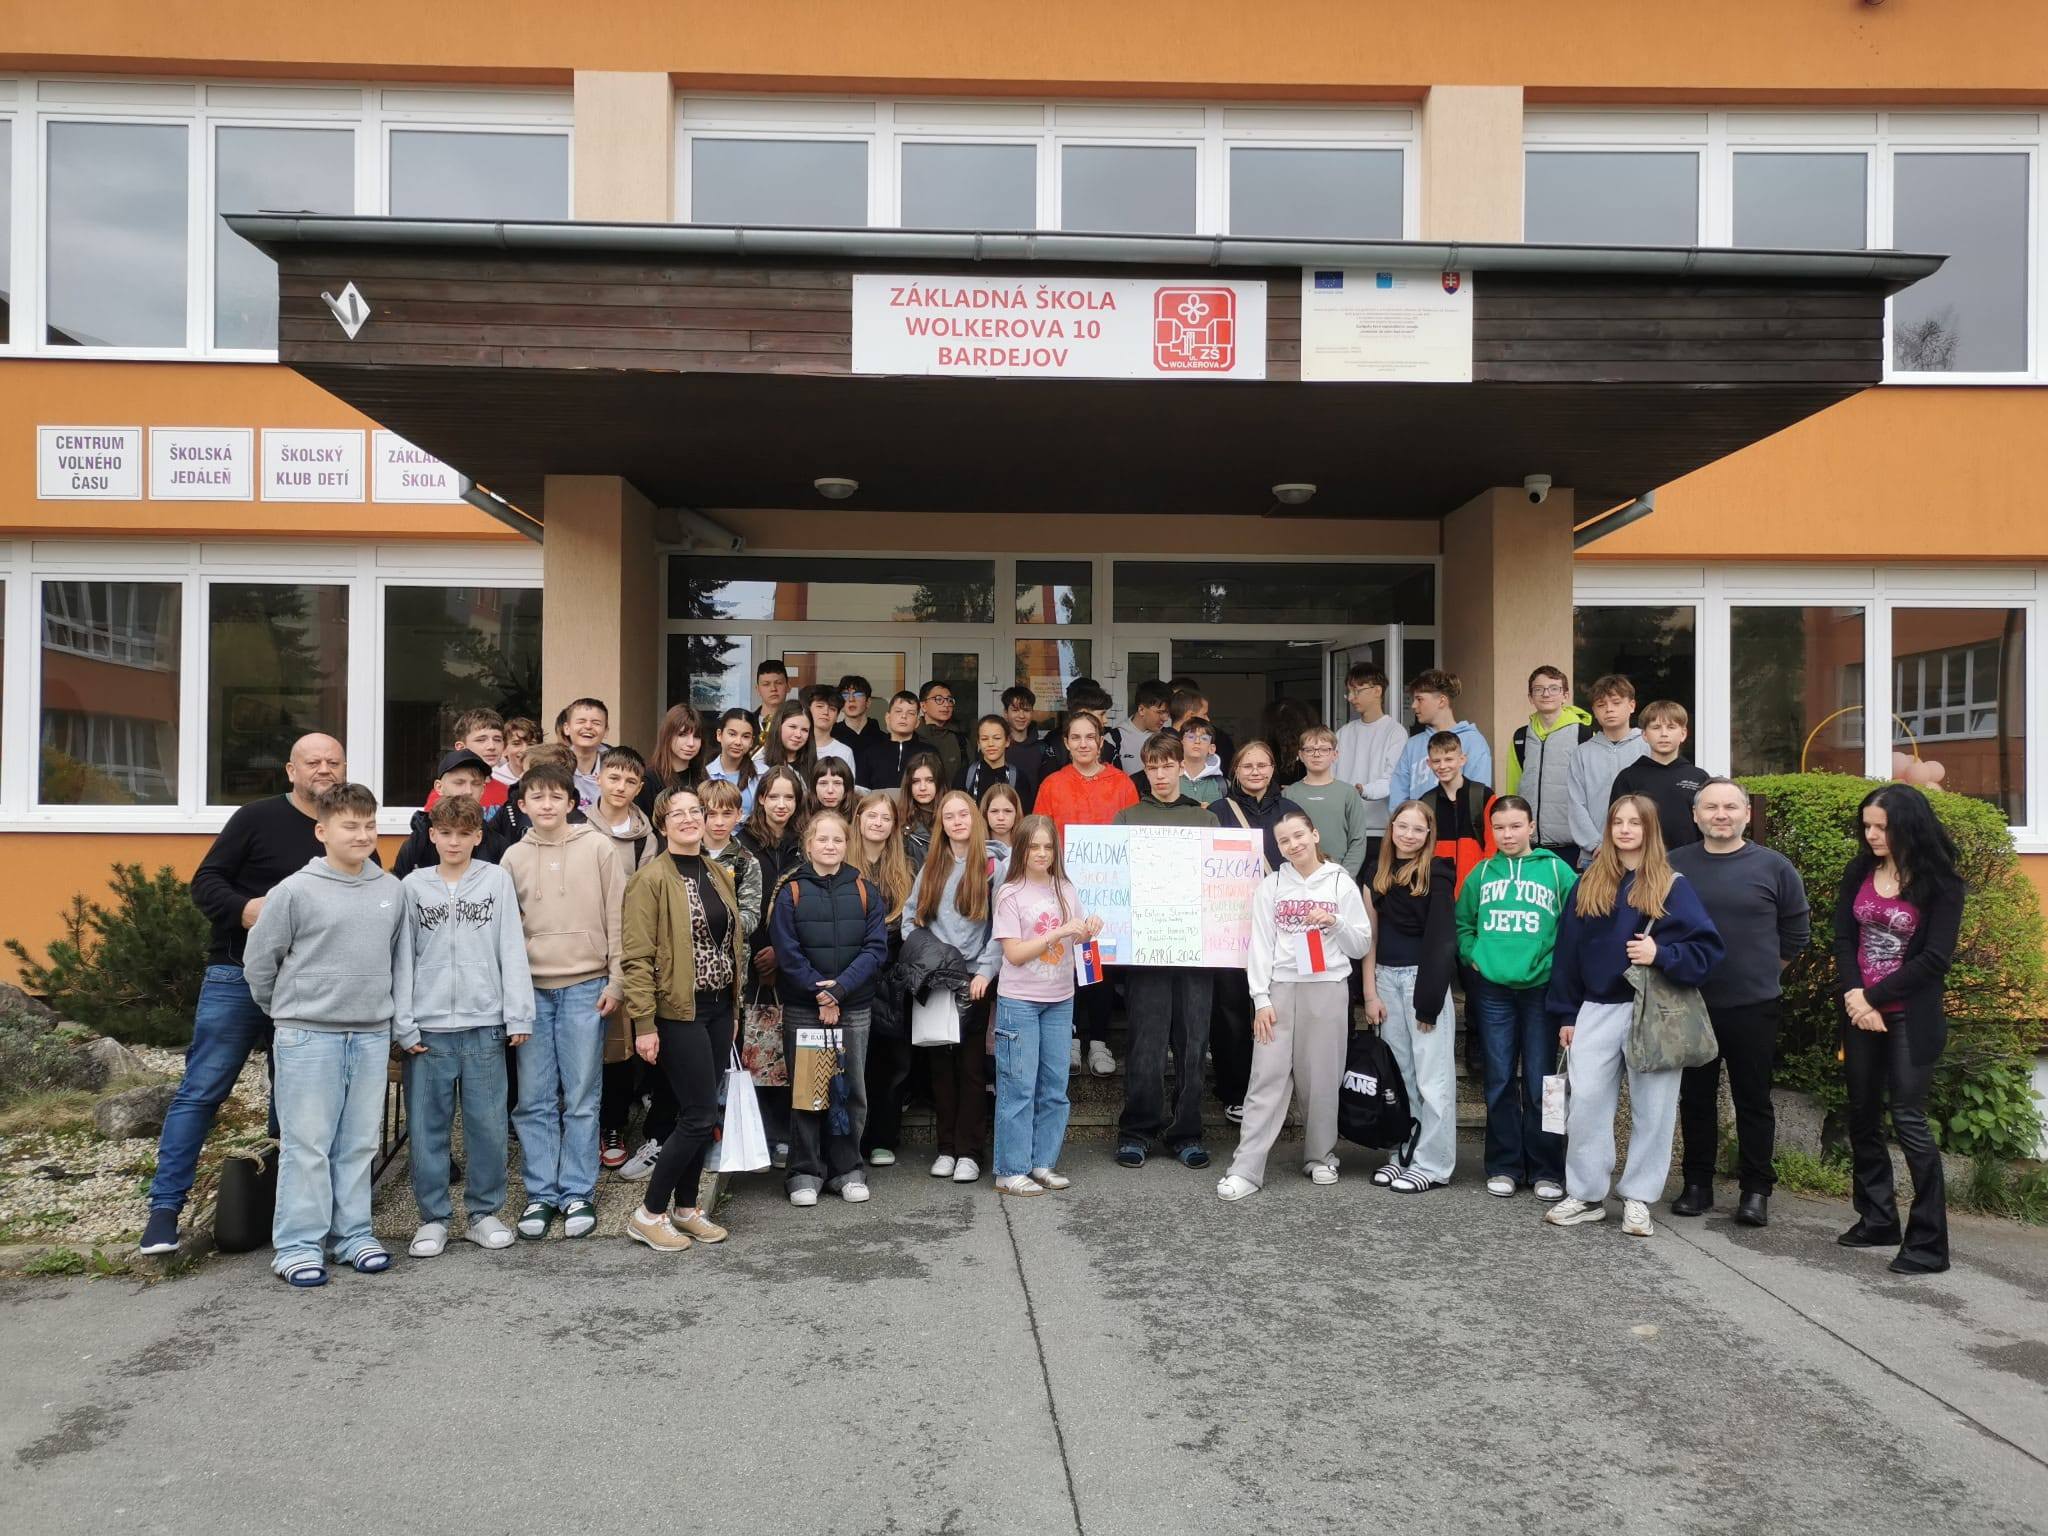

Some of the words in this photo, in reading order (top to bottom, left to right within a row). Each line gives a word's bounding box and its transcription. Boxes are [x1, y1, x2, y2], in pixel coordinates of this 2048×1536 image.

[890, 283, 1026, 309] ZÁKLADNÁ
[1036, 284, 1117, 311] ŠKOLA
[905, 316, 1064, 339] WOLKEROVA
[1073, 319, 1101, 339] 10
[938, 346, 1069, 367] BARDEJOV
[1200, 345, 1220, 360] ZŠ
[56, 435, 124, 450] CENTRUM
[58, 452, 122, 470] VOĽNÉHO
[169, 443, 232, 461] ŠKOLSKÁ
[281, 443, 343, 462] ŠKOLSKÝ
[71, 472, 108, 490] ČASU
[170, 467, 231, 485] JEDÁLEŇ
[276, 472, 312, 486] KLUB
[318, 469, 349, 486] DETÍ
[402, 470, 446, 487] ŠKOLA
[1066, 838, 1129, 865] ZÁKLADNÁ
[1204, 857, 1261, 878] SZKOŁA
[1078, 888, 1131, 906] OLKEROVA
[1514, 880, 1556, 916] YORK
[1484, 909, 1540, 933] JETS
[1135, 947, 1146, 963] 15
